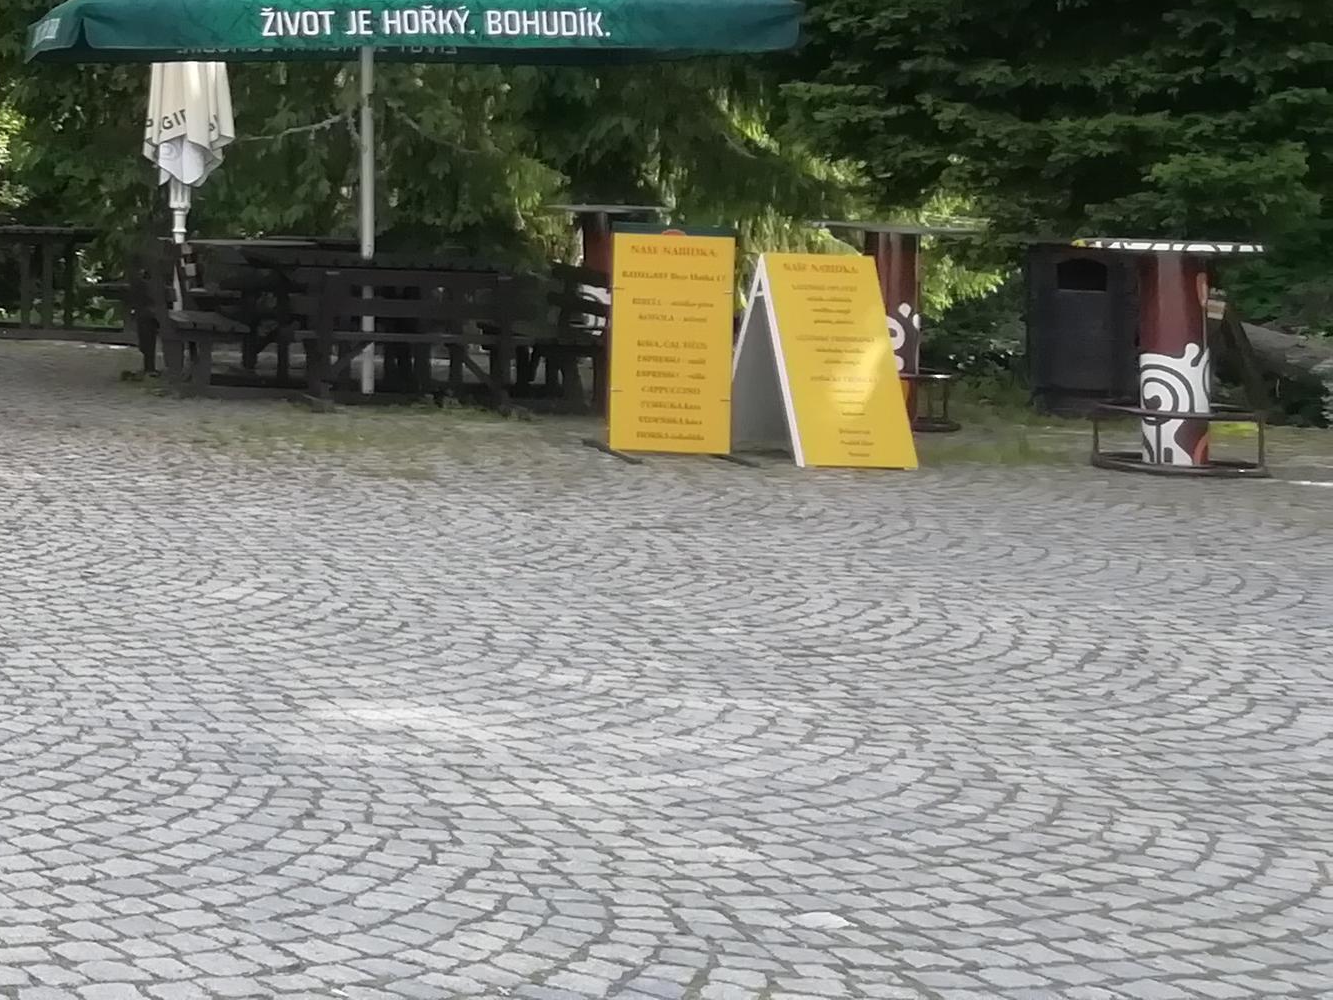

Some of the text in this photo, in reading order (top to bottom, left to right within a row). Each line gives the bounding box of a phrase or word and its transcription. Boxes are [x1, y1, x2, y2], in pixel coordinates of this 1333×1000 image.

[260, 4, 611, 37] ŽIVOT JE HOŘKÝ. BOHUDÍK.
